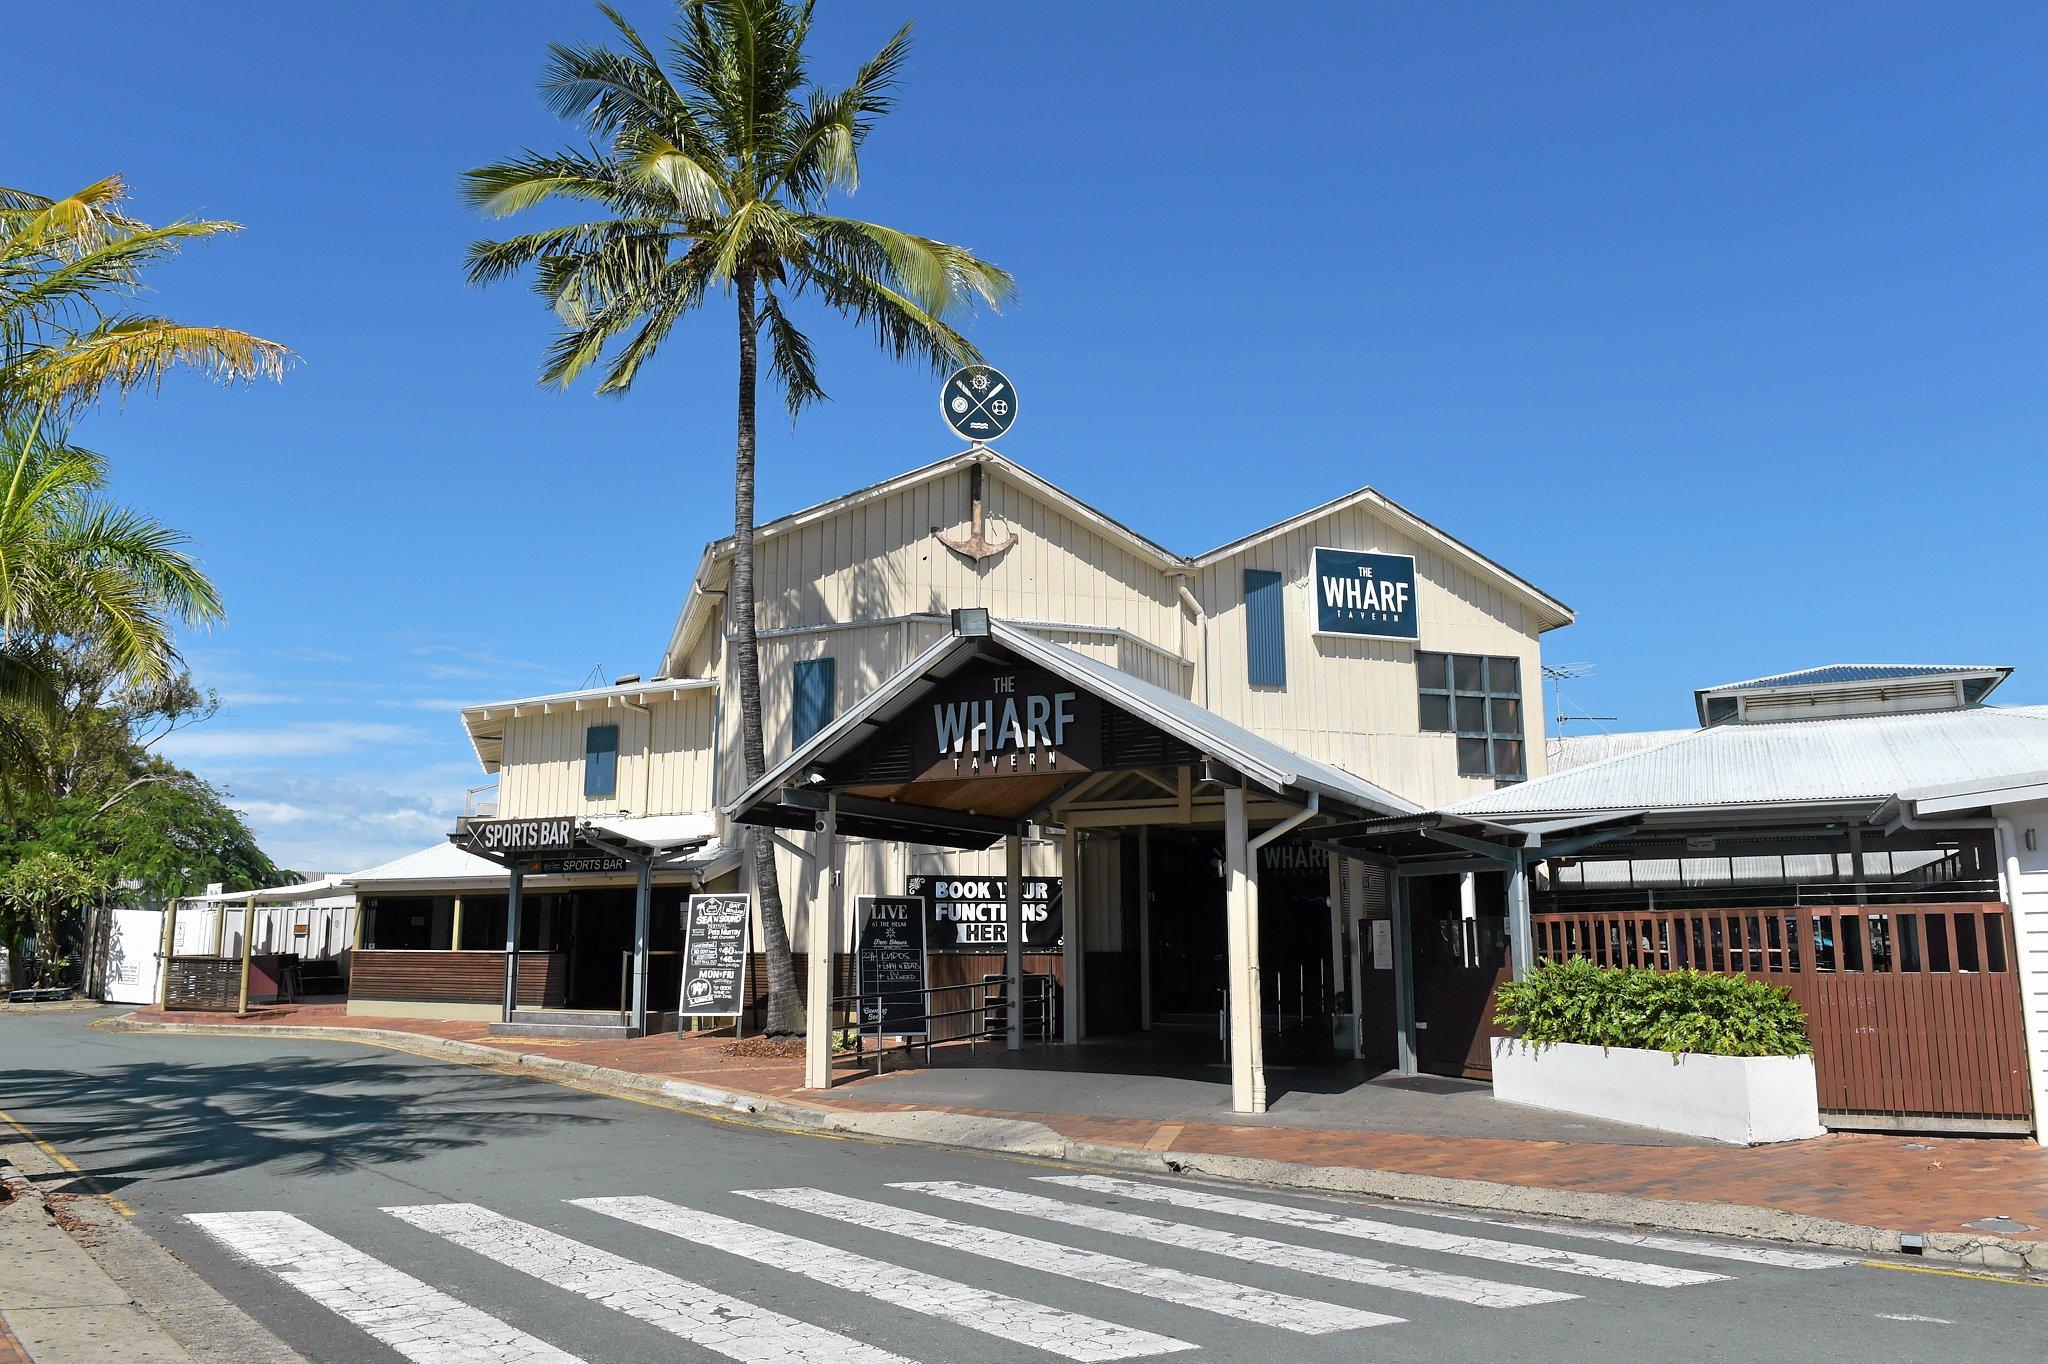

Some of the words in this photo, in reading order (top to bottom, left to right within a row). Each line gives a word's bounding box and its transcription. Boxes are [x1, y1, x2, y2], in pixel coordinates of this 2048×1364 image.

[1358, 566, 1373, 577] THE
[1322, 576, 1408, 613] WHARF
[1336, 610, 1399, 622] TAVERN
[993, 676, 1015, 693] THE
[933, 692, 1076, 754] WHARF
[953, 752, 1056, 770] TAVERN
[484, 822, 538, 848] SPORTS
[540, 820, 570, 846] BAR
[562, 859, 601, 871] SPORTS
[602, 858, 624, 870] BAR
[935, 881, 990, 899] BOOK
[996, 881, 1048, 899] YUR
[695, 915, 713, 925] SEA
[719, 914, 742, 923] SOUND
[871, 904, 908, 920] LIVE
[935, 903, 1048, 922] FUNCTINS
[722, 929, 742, 939] Murray
[965, 924, 1007, 942] HER
